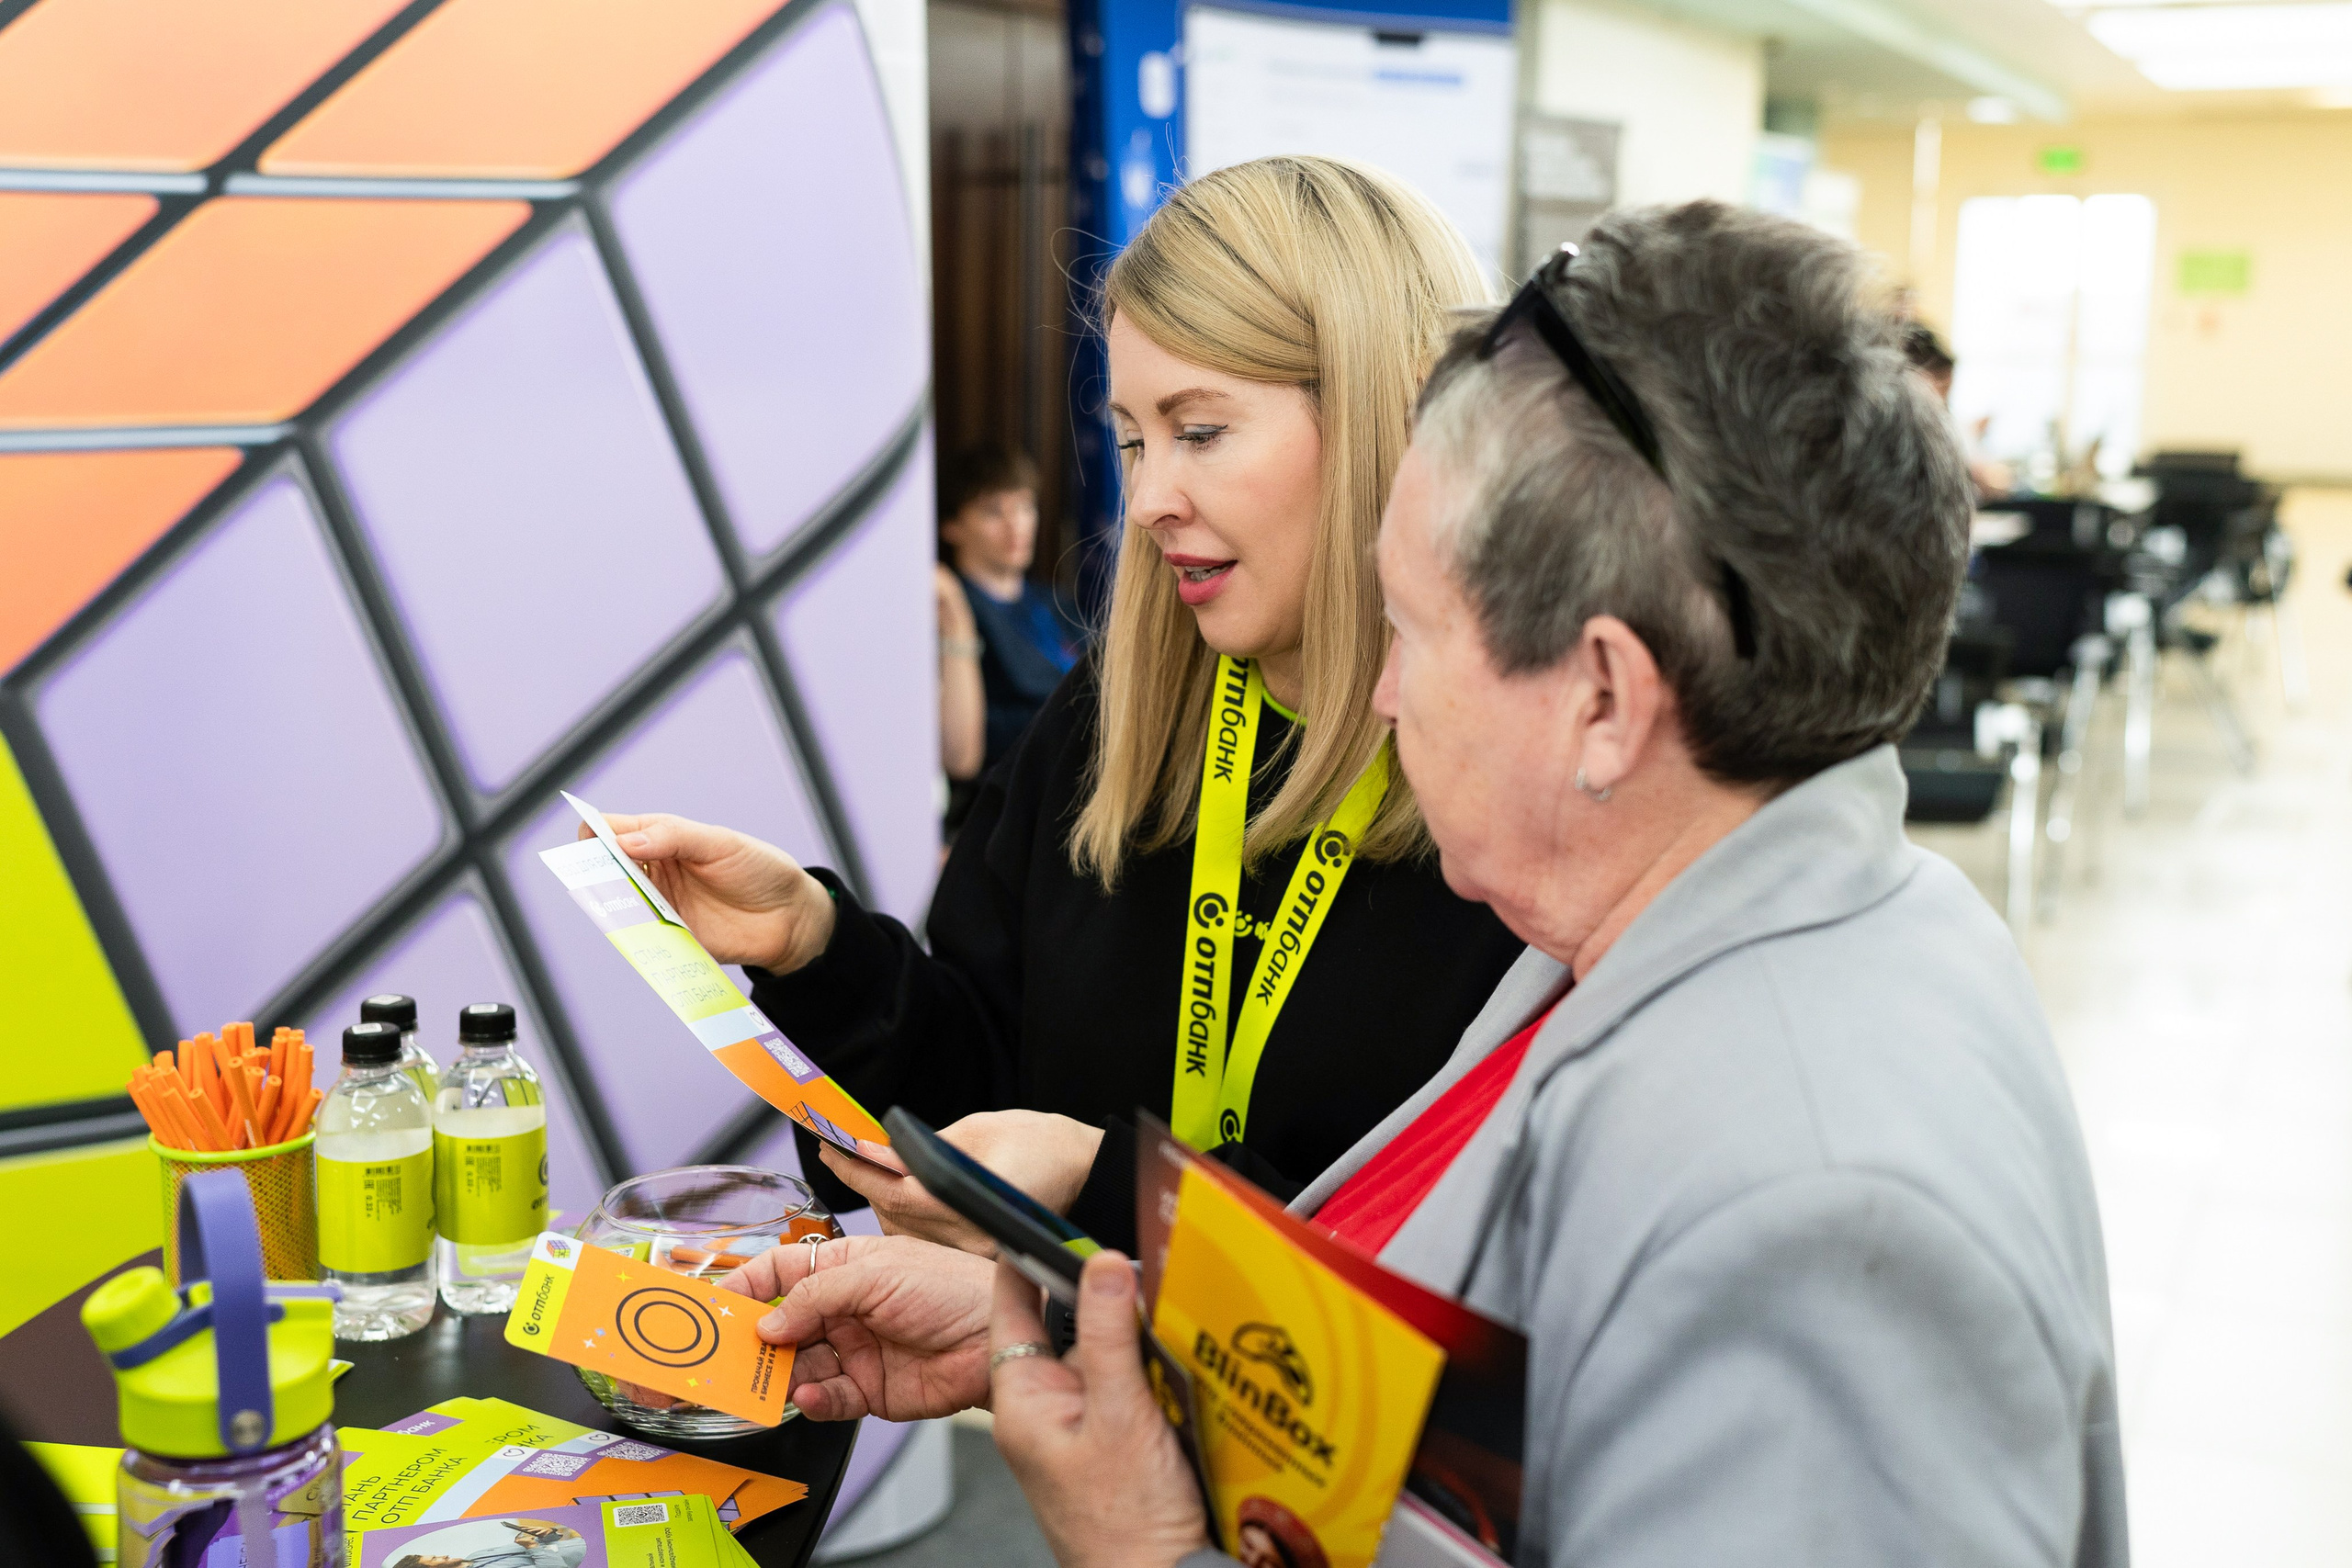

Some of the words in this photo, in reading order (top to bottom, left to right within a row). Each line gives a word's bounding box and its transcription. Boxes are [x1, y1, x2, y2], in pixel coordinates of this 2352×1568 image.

[633, 944, 672, 965] СТАНЬ
[650, 960, 714, 987] ПАРТНЕРОМ
[671, 989, 696, 1008] ОТП
[691, 982, 729, 1002] БАНКА
[531, 1273, 555, 1321] отпбанк
[751, 1356, 764, 1393] ПРОКАЧАЙ
[761, 1365, 773, 1394] БИЗНЕСЕ
[1194, 1330, 1337, 1467] BlinBox
[397, 1419, 435, 1435] банк
[352, 1447, 448, 1521] ПАРТНЕРОМ
[380, 1495, 420, 1524] ОТП
[416, 1456, 468, 1494] БАНКА
